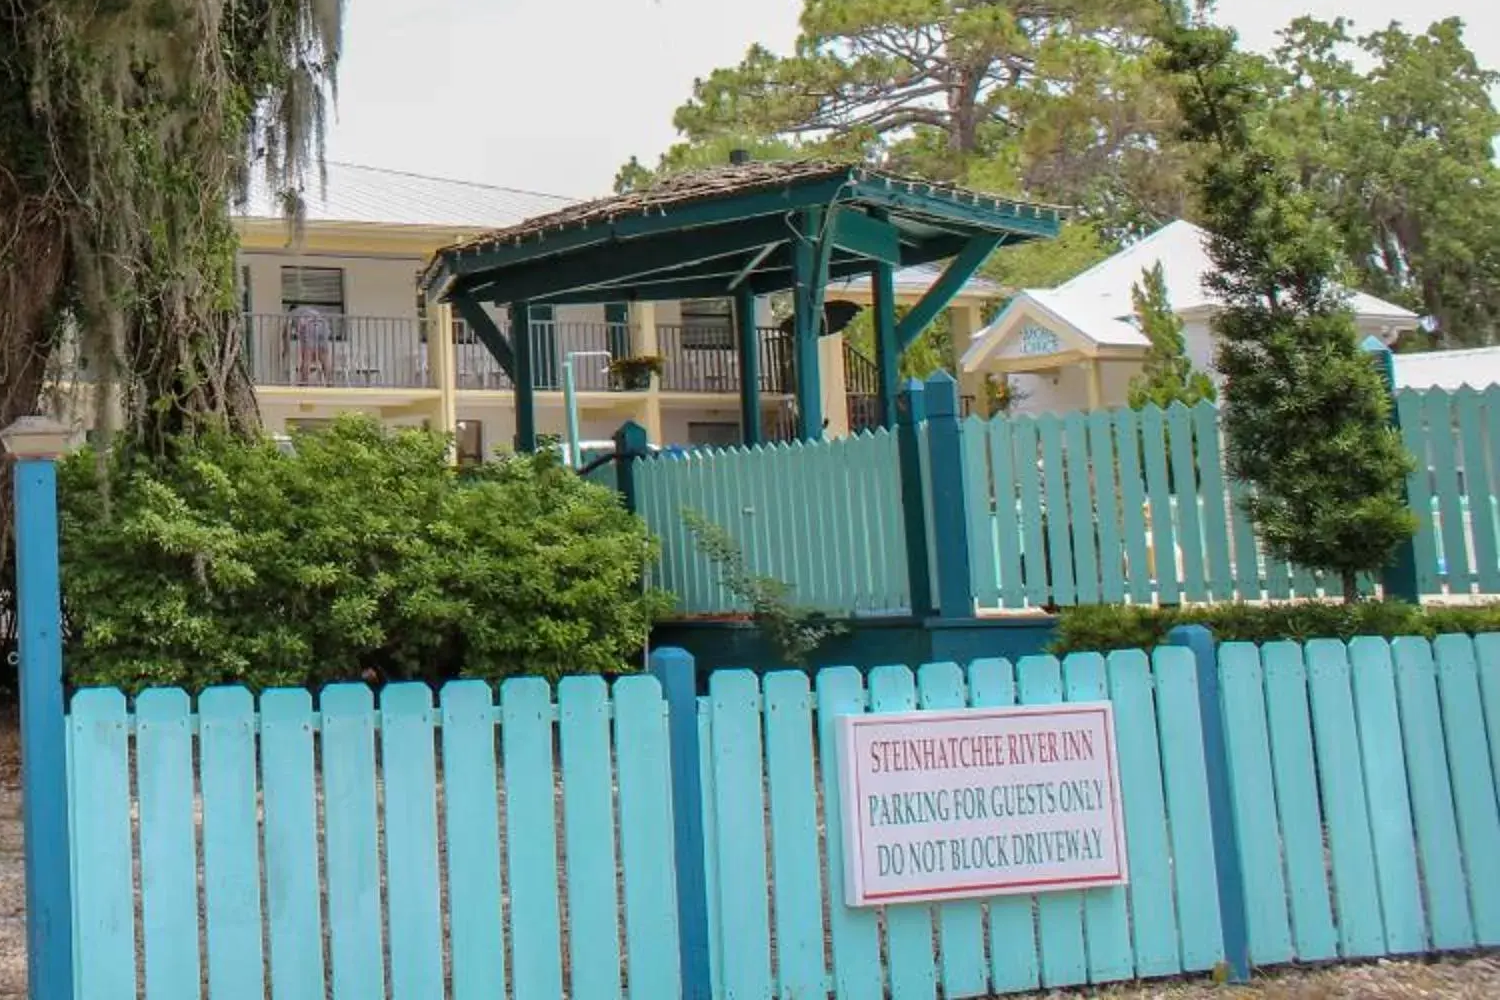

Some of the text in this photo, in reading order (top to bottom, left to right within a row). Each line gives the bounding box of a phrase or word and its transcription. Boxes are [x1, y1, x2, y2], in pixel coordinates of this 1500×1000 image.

[870, 729, 1096, 774] STEINHATCHEE RIVER INN
[868, 779, 1104, 826] PARKING FOR GUESTS ONLY
[877, 827, 1104, 877] DO NOT BLOCK DRIVEWAY
